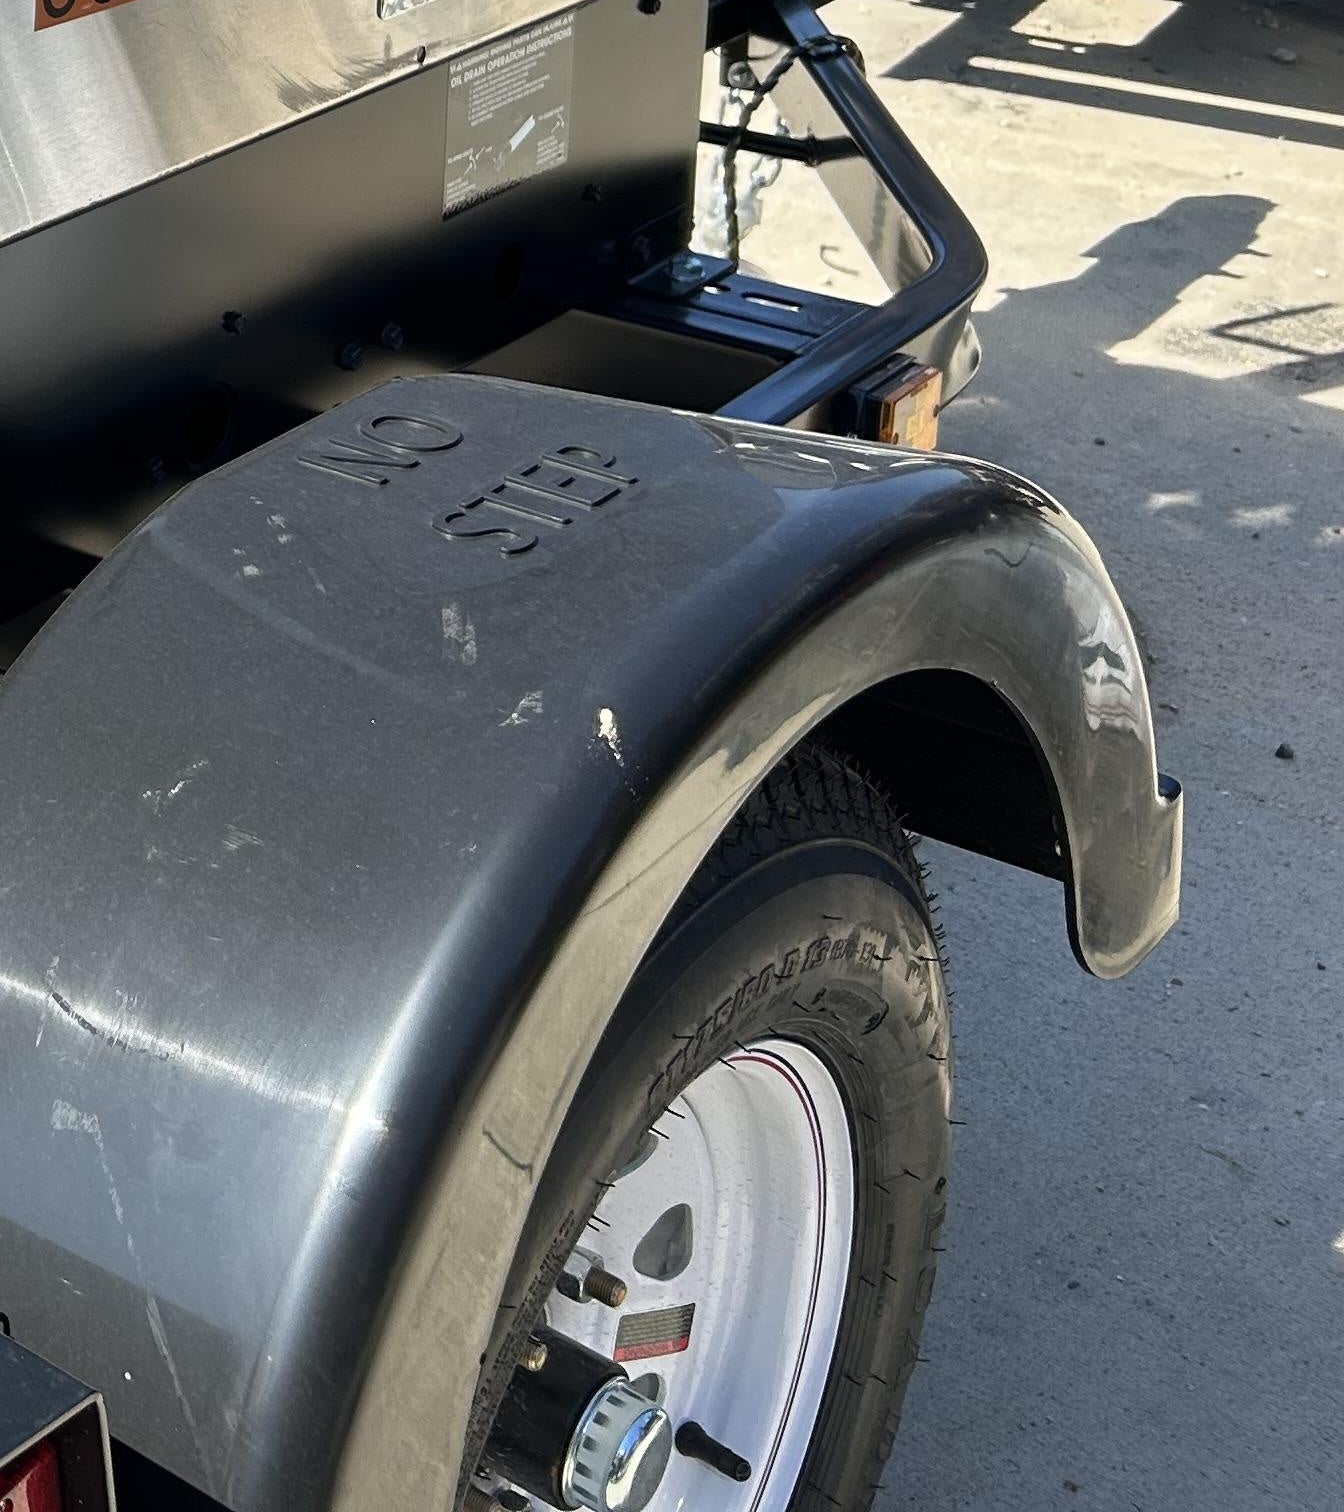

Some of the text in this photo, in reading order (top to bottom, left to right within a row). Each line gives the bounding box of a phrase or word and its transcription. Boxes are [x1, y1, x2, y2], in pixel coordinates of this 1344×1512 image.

[451, 26, 572, 88] OIL DRAIN OPERATION INSTRUCTIONS
[296, 413, 464, 486] NO
[431, 444, 640, 559] STEP
